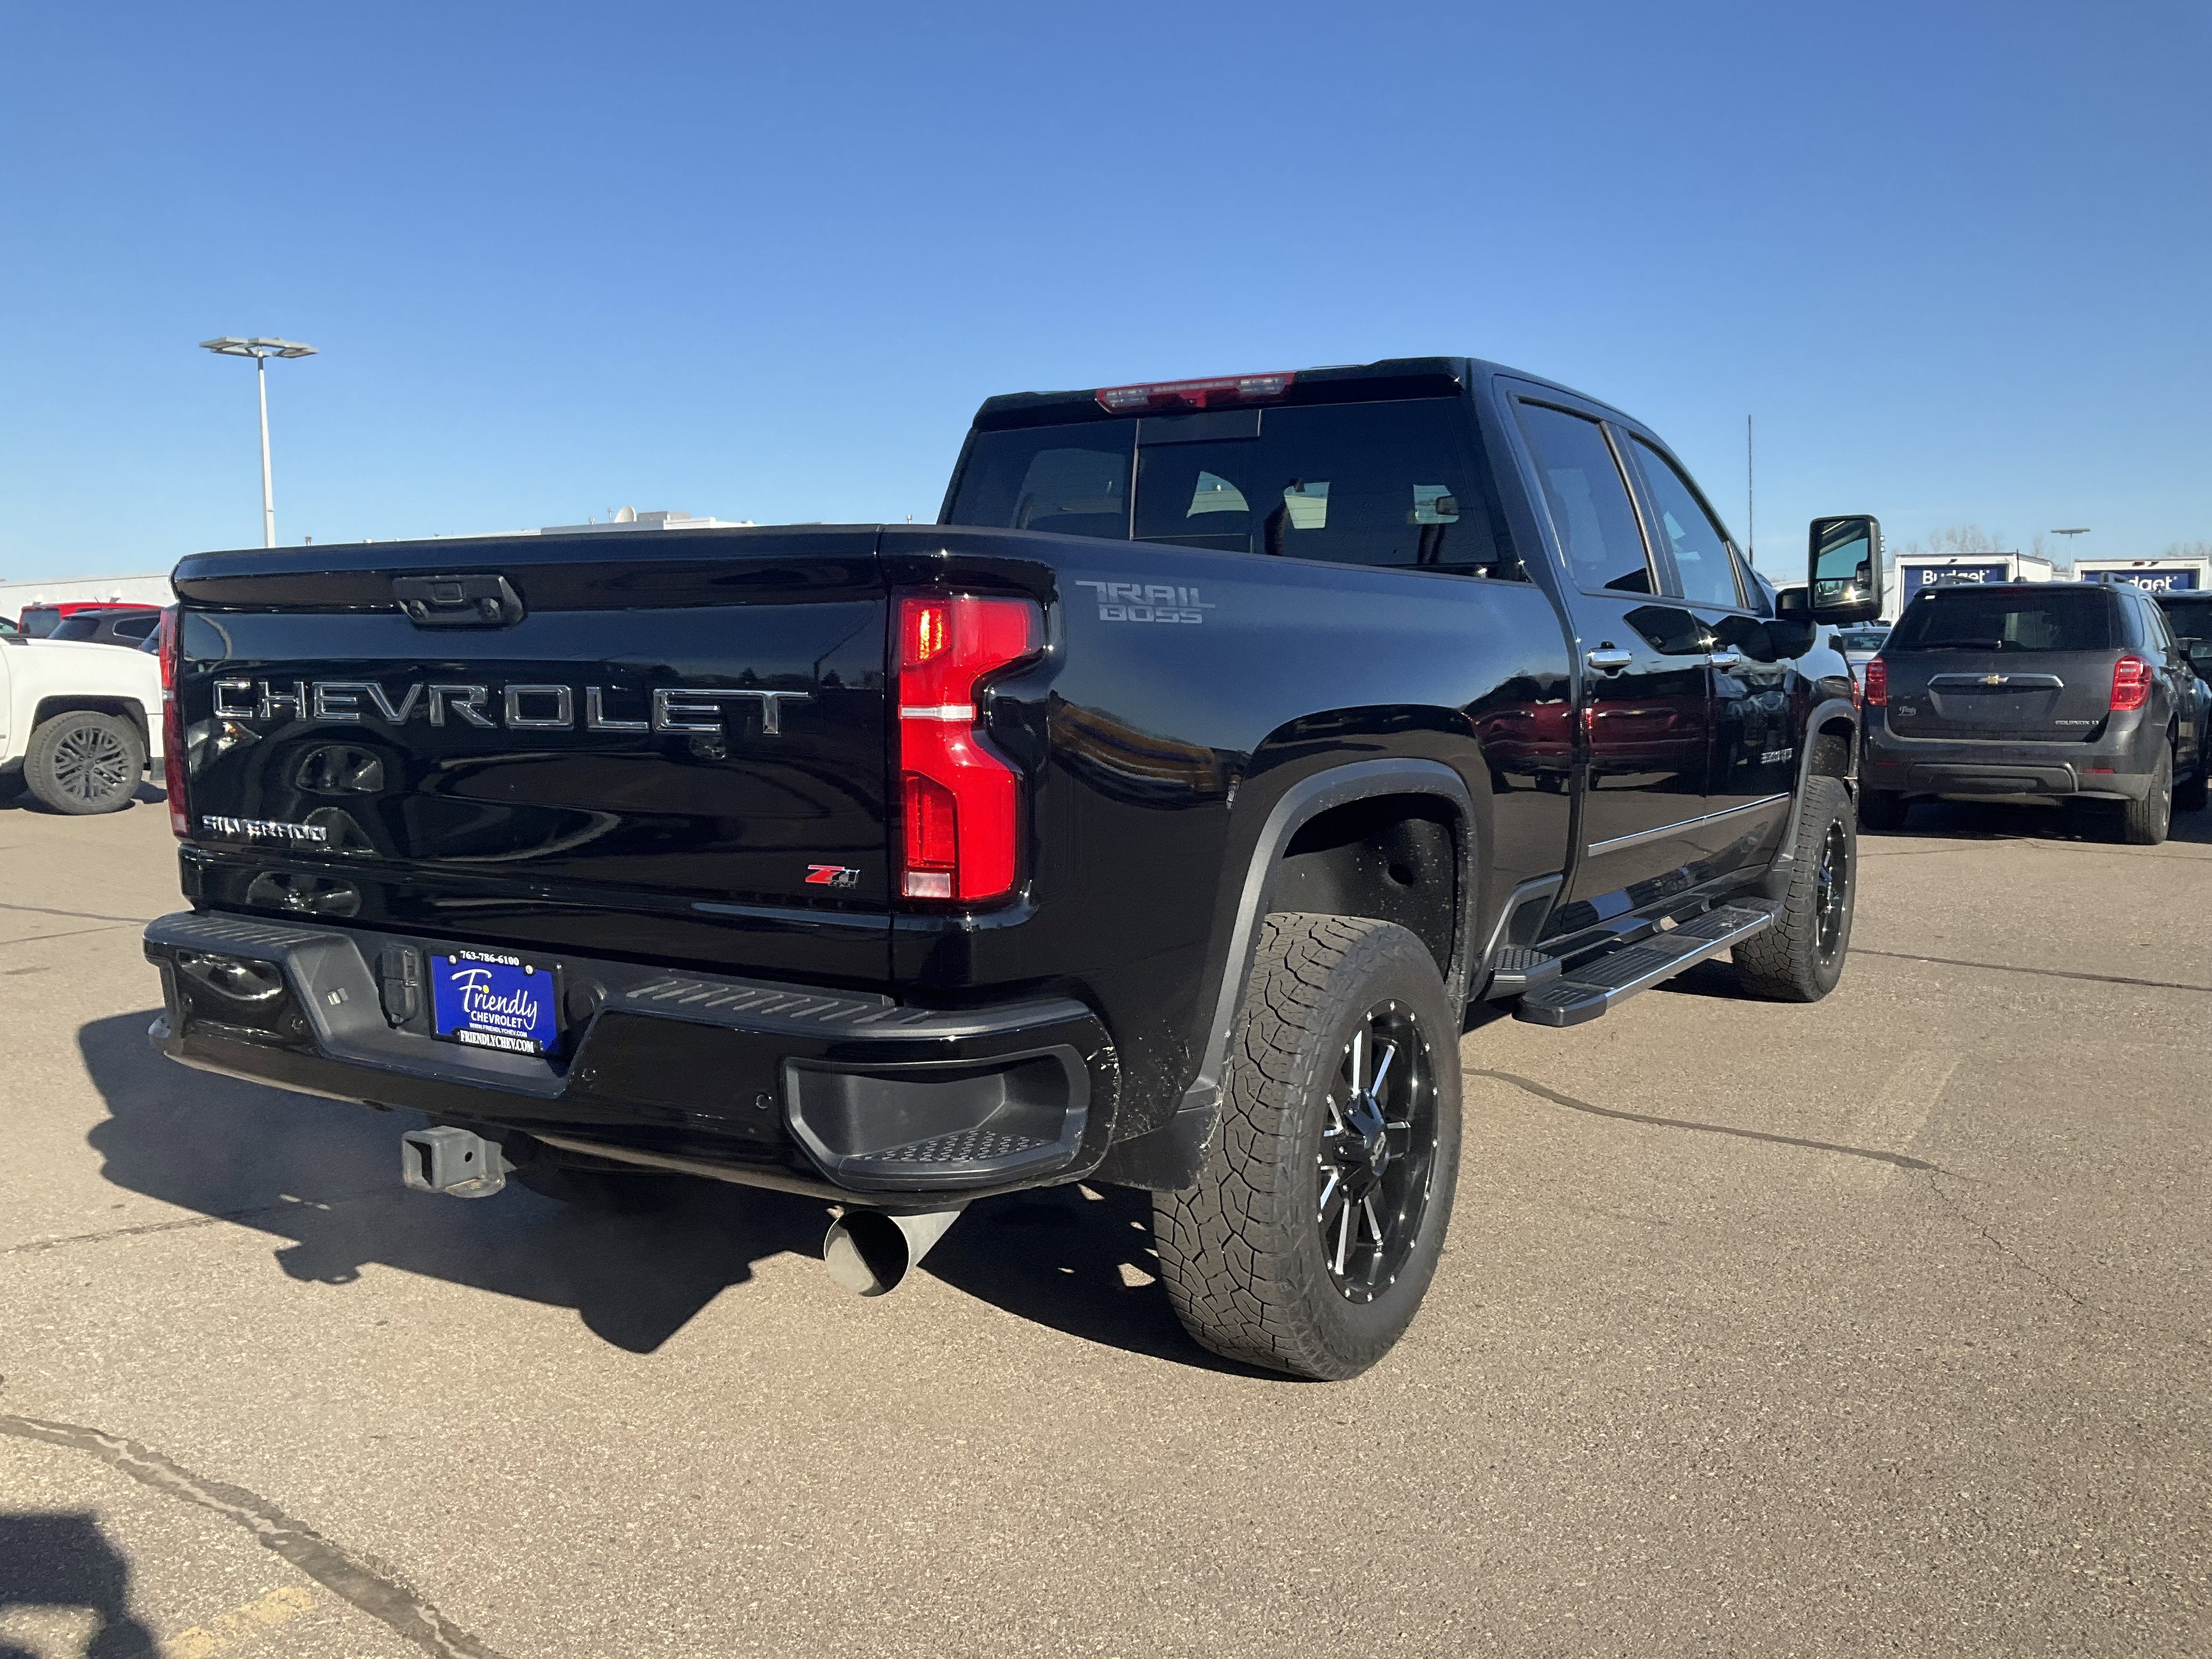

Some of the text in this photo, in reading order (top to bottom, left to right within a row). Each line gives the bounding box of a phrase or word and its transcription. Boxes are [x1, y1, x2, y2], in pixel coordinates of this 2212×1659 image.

[2129, 575, 2173, 590] dget
[1075, 580, 1216, 610] TRAIL
[1099, 604, 1203, 624] BOSS
[213, 678, 812, 736] CHEVROLET
[460, 950, 520, 966] 763-786-6100
[451, 968, 537, 1030] Friendly
[469, 1022, 528, 1037] WWW.FRIENDLYCHEV.COM
[471, 1010, 523, 1029] CHEVROLET
[460, 1030, 535, 1053] FRIENDLYCHEV.COM
